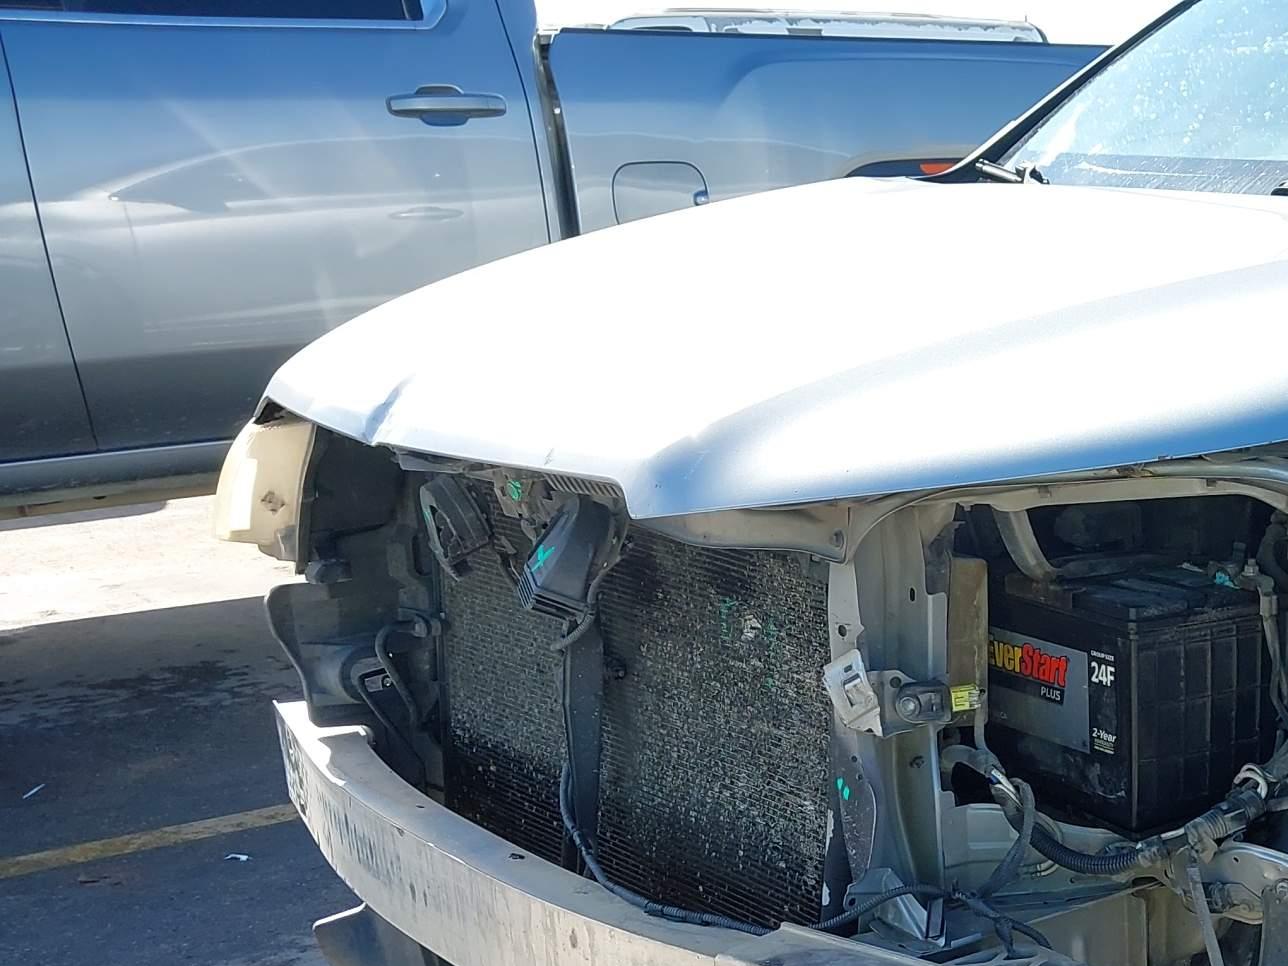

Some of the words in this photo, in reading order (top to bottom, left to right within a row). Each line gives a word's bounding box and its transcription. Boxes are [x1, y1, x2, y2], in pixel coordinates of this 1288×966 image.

[1091, 662, 1116, 686] 24F
[1041, 686, 1061, 701] PLUS
[1092, 728, 1117, 742] 2-Year
